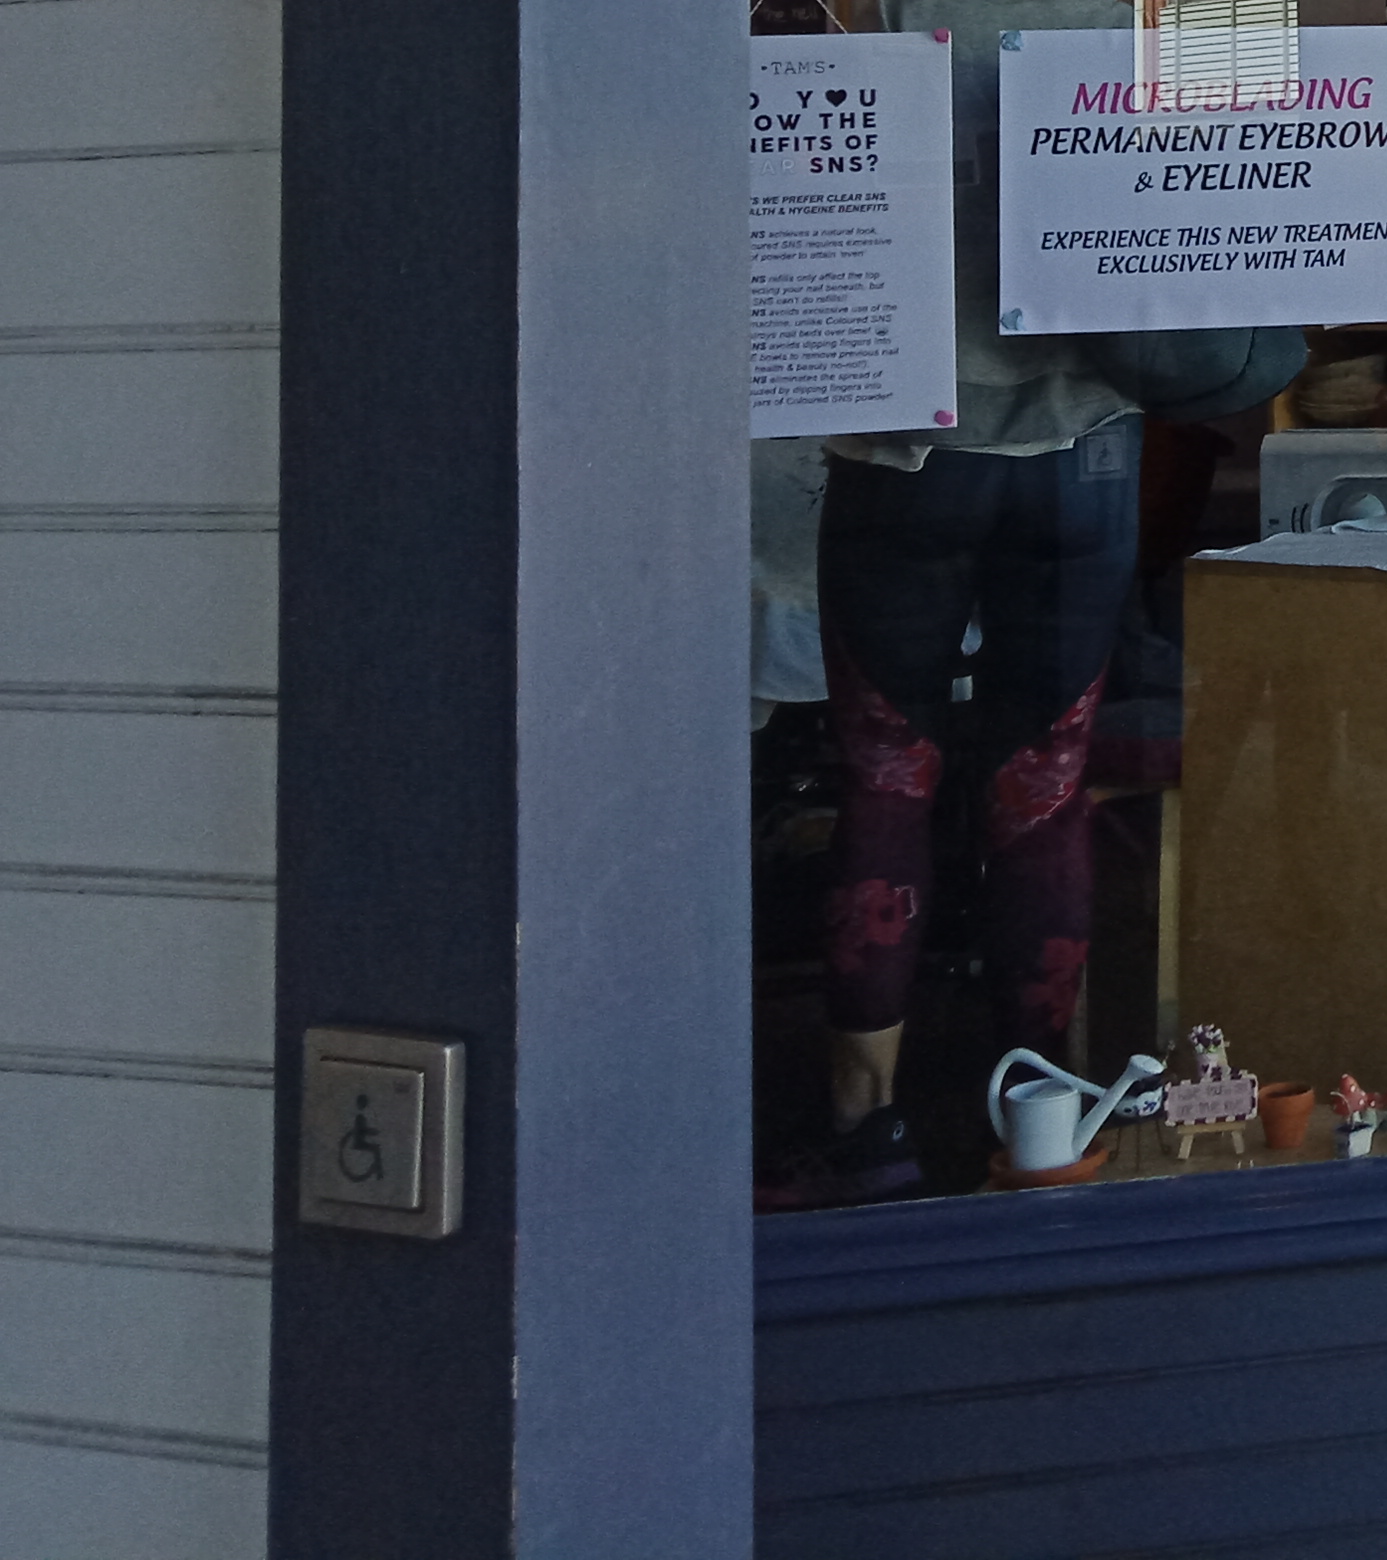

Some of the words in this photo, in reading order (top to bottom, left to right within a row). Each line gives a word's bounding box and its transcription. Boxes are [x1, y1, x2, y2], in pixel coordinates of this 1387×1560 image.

[1071, 77, 1373, 115] MICROBLADING
[754, 114, 801, 132] OW
[818, 111, 877, 130] THE
[750, 135, 833, 153] EFITS
[845, 134, 878, 150] OF
[1030, 124, 1235, 156] PERMANENT
[810, 153, 879, 174] SNS?
[1135, 171, 1154, 193] &
[1162, 161, 1312, 192] EYELINER
[763, 196, 779, 204] WE
[782, 194, 823, 203] PREFER
[827, 193, 862, 203] CLEAR
[750, 207, 775, 216] ALTH
[838, 204, 889, 213] BENEFITS
[751, 231, 765, 239] NS
[1041, 228, 1171, 250] EXPERIENCE
[1176, 226, 1221, 247] THIS
[1227, 225, 1279, 246] NEW
[1097, 251, 1239, 275] EXCLUSIVELY
[1244, 248, 1296, 271] WITH
[1303, 248, 1346, 268] TAM
[751, 275, 766, 283] NS
[752, 309, 766, 317] NS
[752, 376, 767, 384] NS
